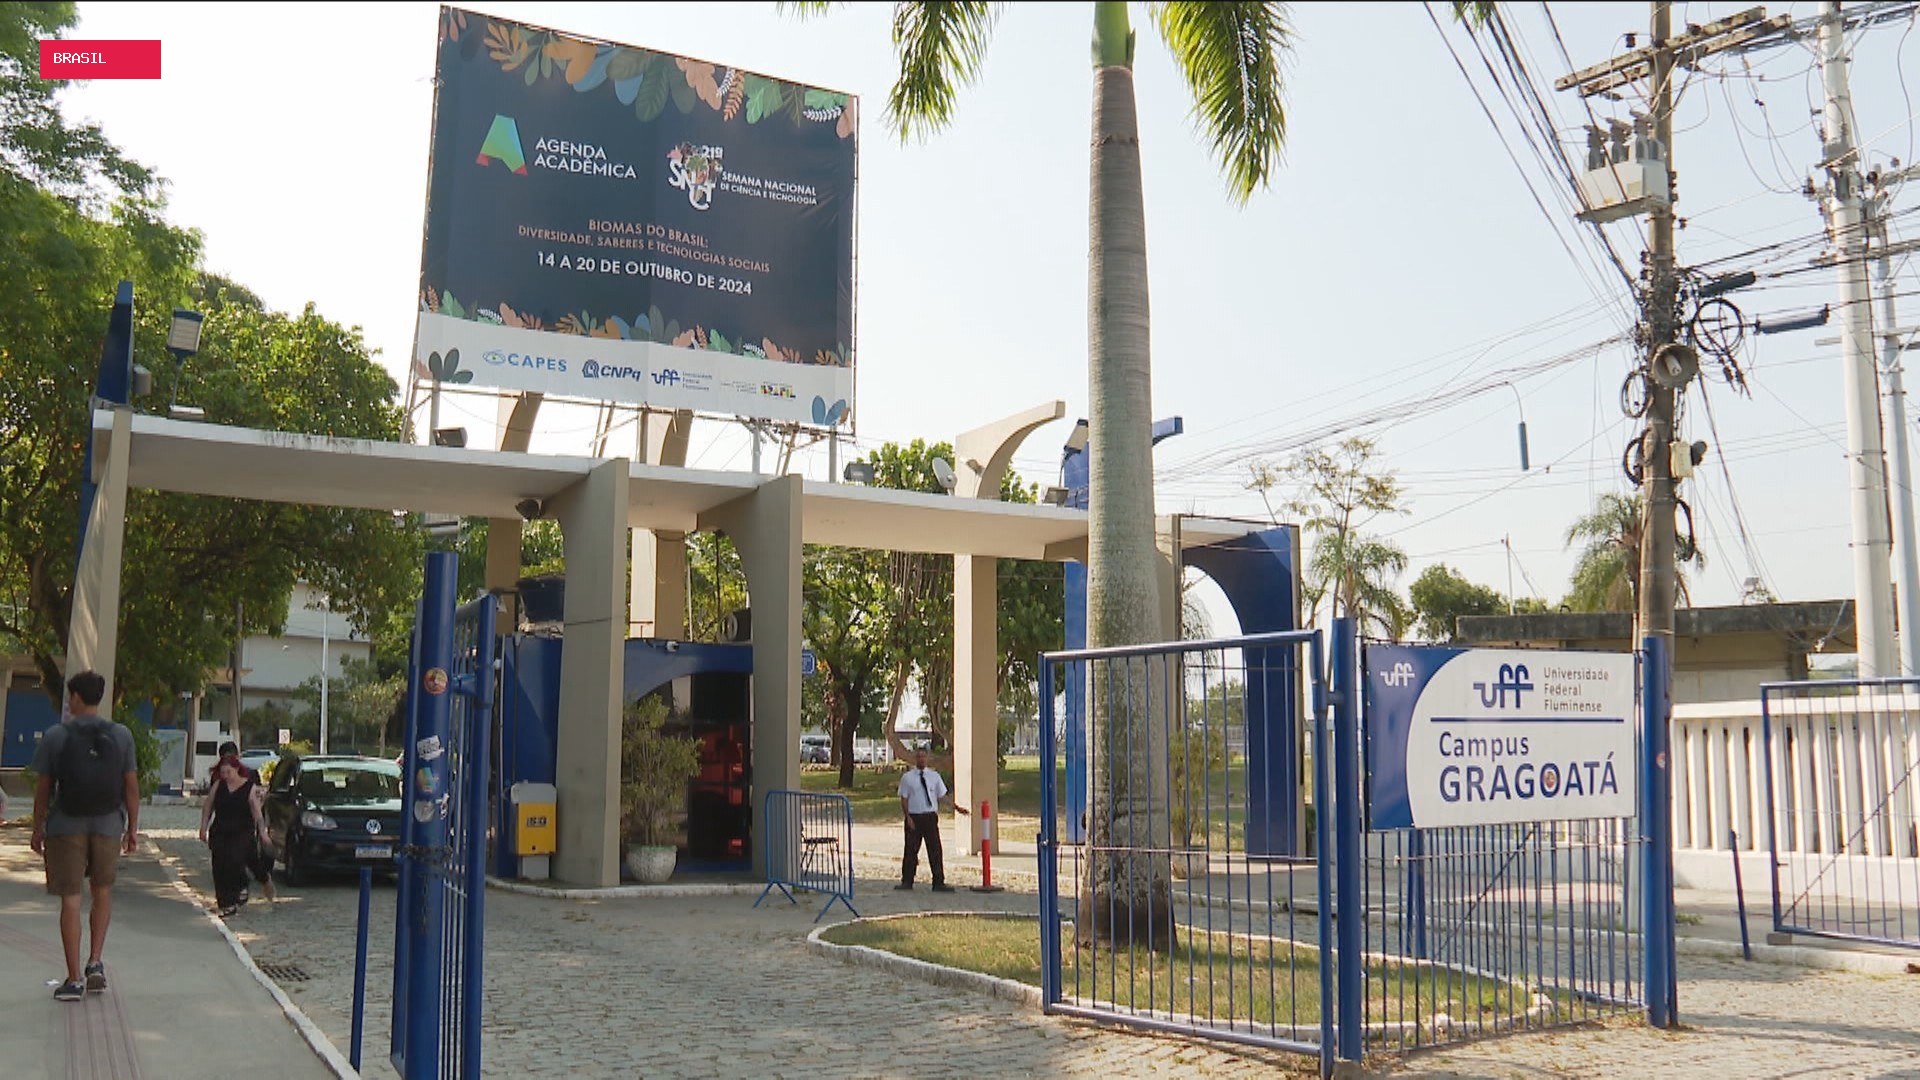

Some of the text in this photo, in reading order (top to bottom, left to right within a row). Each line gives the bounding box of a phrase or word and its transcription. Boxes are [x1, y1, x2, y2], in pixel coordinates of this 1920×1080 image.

[535, 137, 607, 160] AGENDA
[534, 153, 637, 179] ACADÊMICA
[720, 182, 817, 205] DE CIÊNCIA E TECNOLOGIA
[722, 171, 817, 196] SEMANA NACIONAL
[588, 219, 709, 248] BIOMAS DO BRASIL:
[518, 225, 770, 272] DIVERSIDADE, SABERES E TECNOLOGIAS SOCIAIS
[538, 251, 752, 295] 14 A 20 DE OUTUBRO DE 2024
[507, 353, 567, 372] CAPES
[600, 365, 641, 382] CNPq
[1544, 666, 1609, 680] Universidade
[1544, 683, 1582, 696] Federal
[1544, 700, 1602, 712] Fluminense
[1438, 731, 1530, 763] Campus
[1439, 751, 1619, 803] GRAGOATÁ
